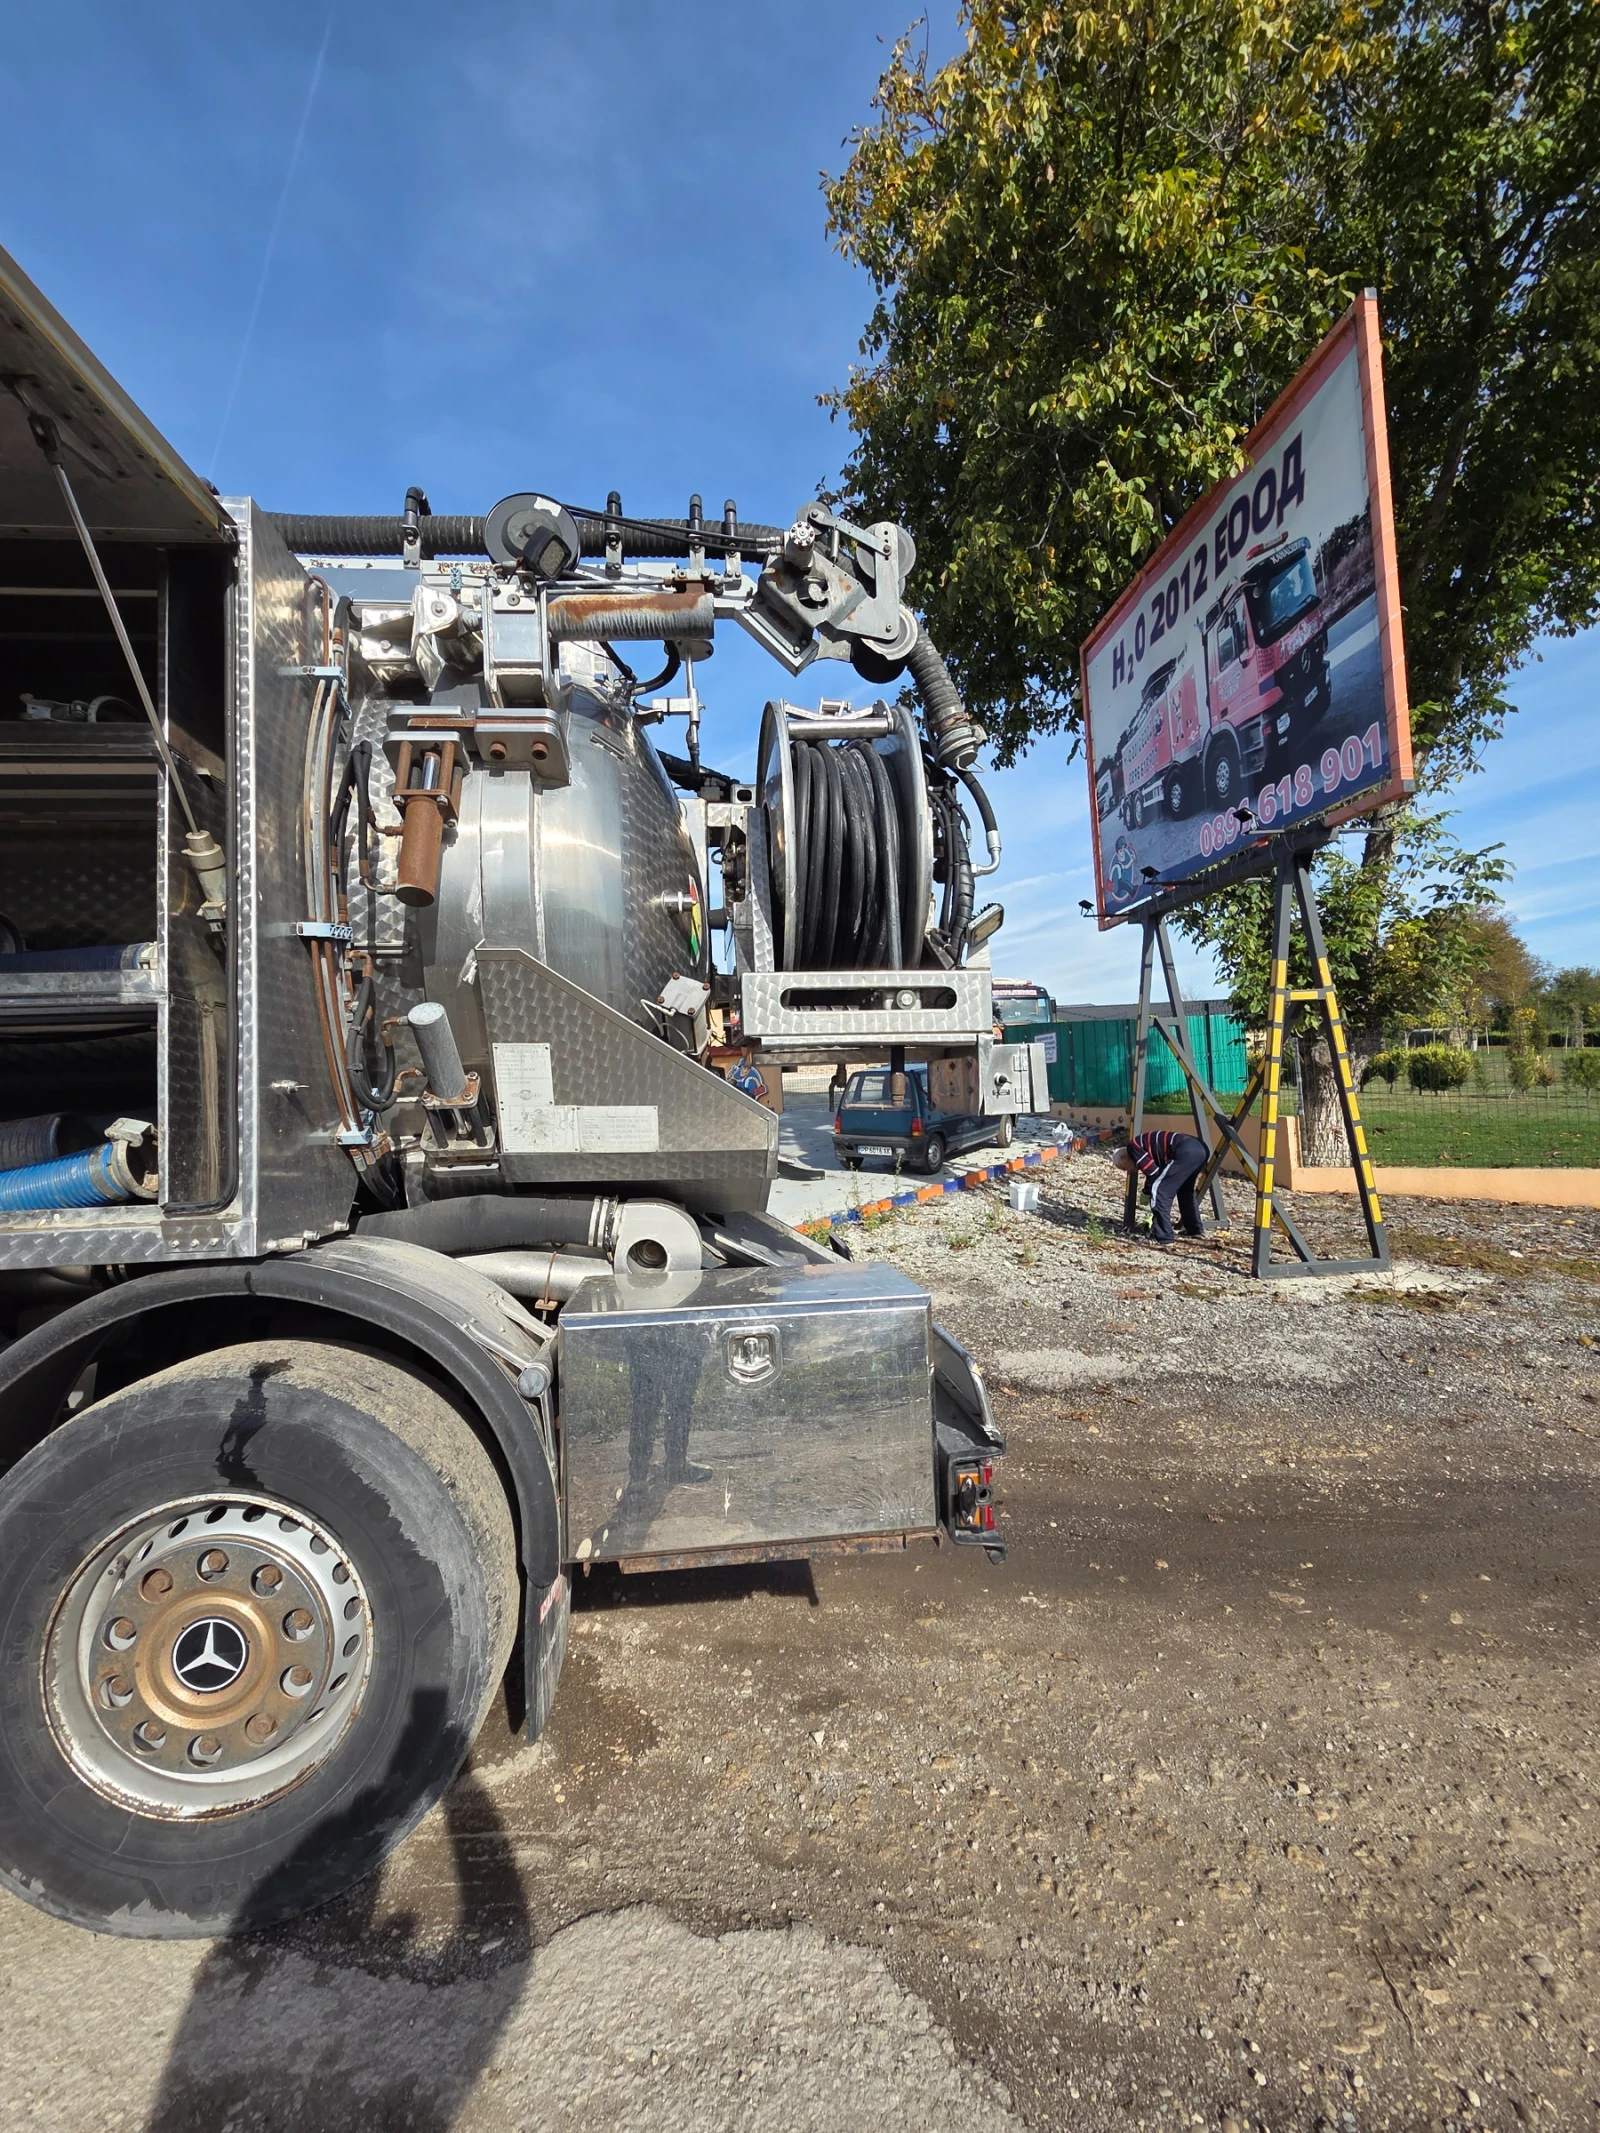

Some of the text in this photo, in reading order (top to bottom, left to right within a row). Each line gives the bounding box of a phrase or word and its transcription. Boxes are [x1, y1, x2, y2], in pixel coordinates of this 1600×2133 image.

[1150, 543, 1209, 647] 2012
[1215, 429, 1306, 581] ЕООД
[1258, 764, 1314, 824] 618
[1321, 721, 1382, 793] 901
